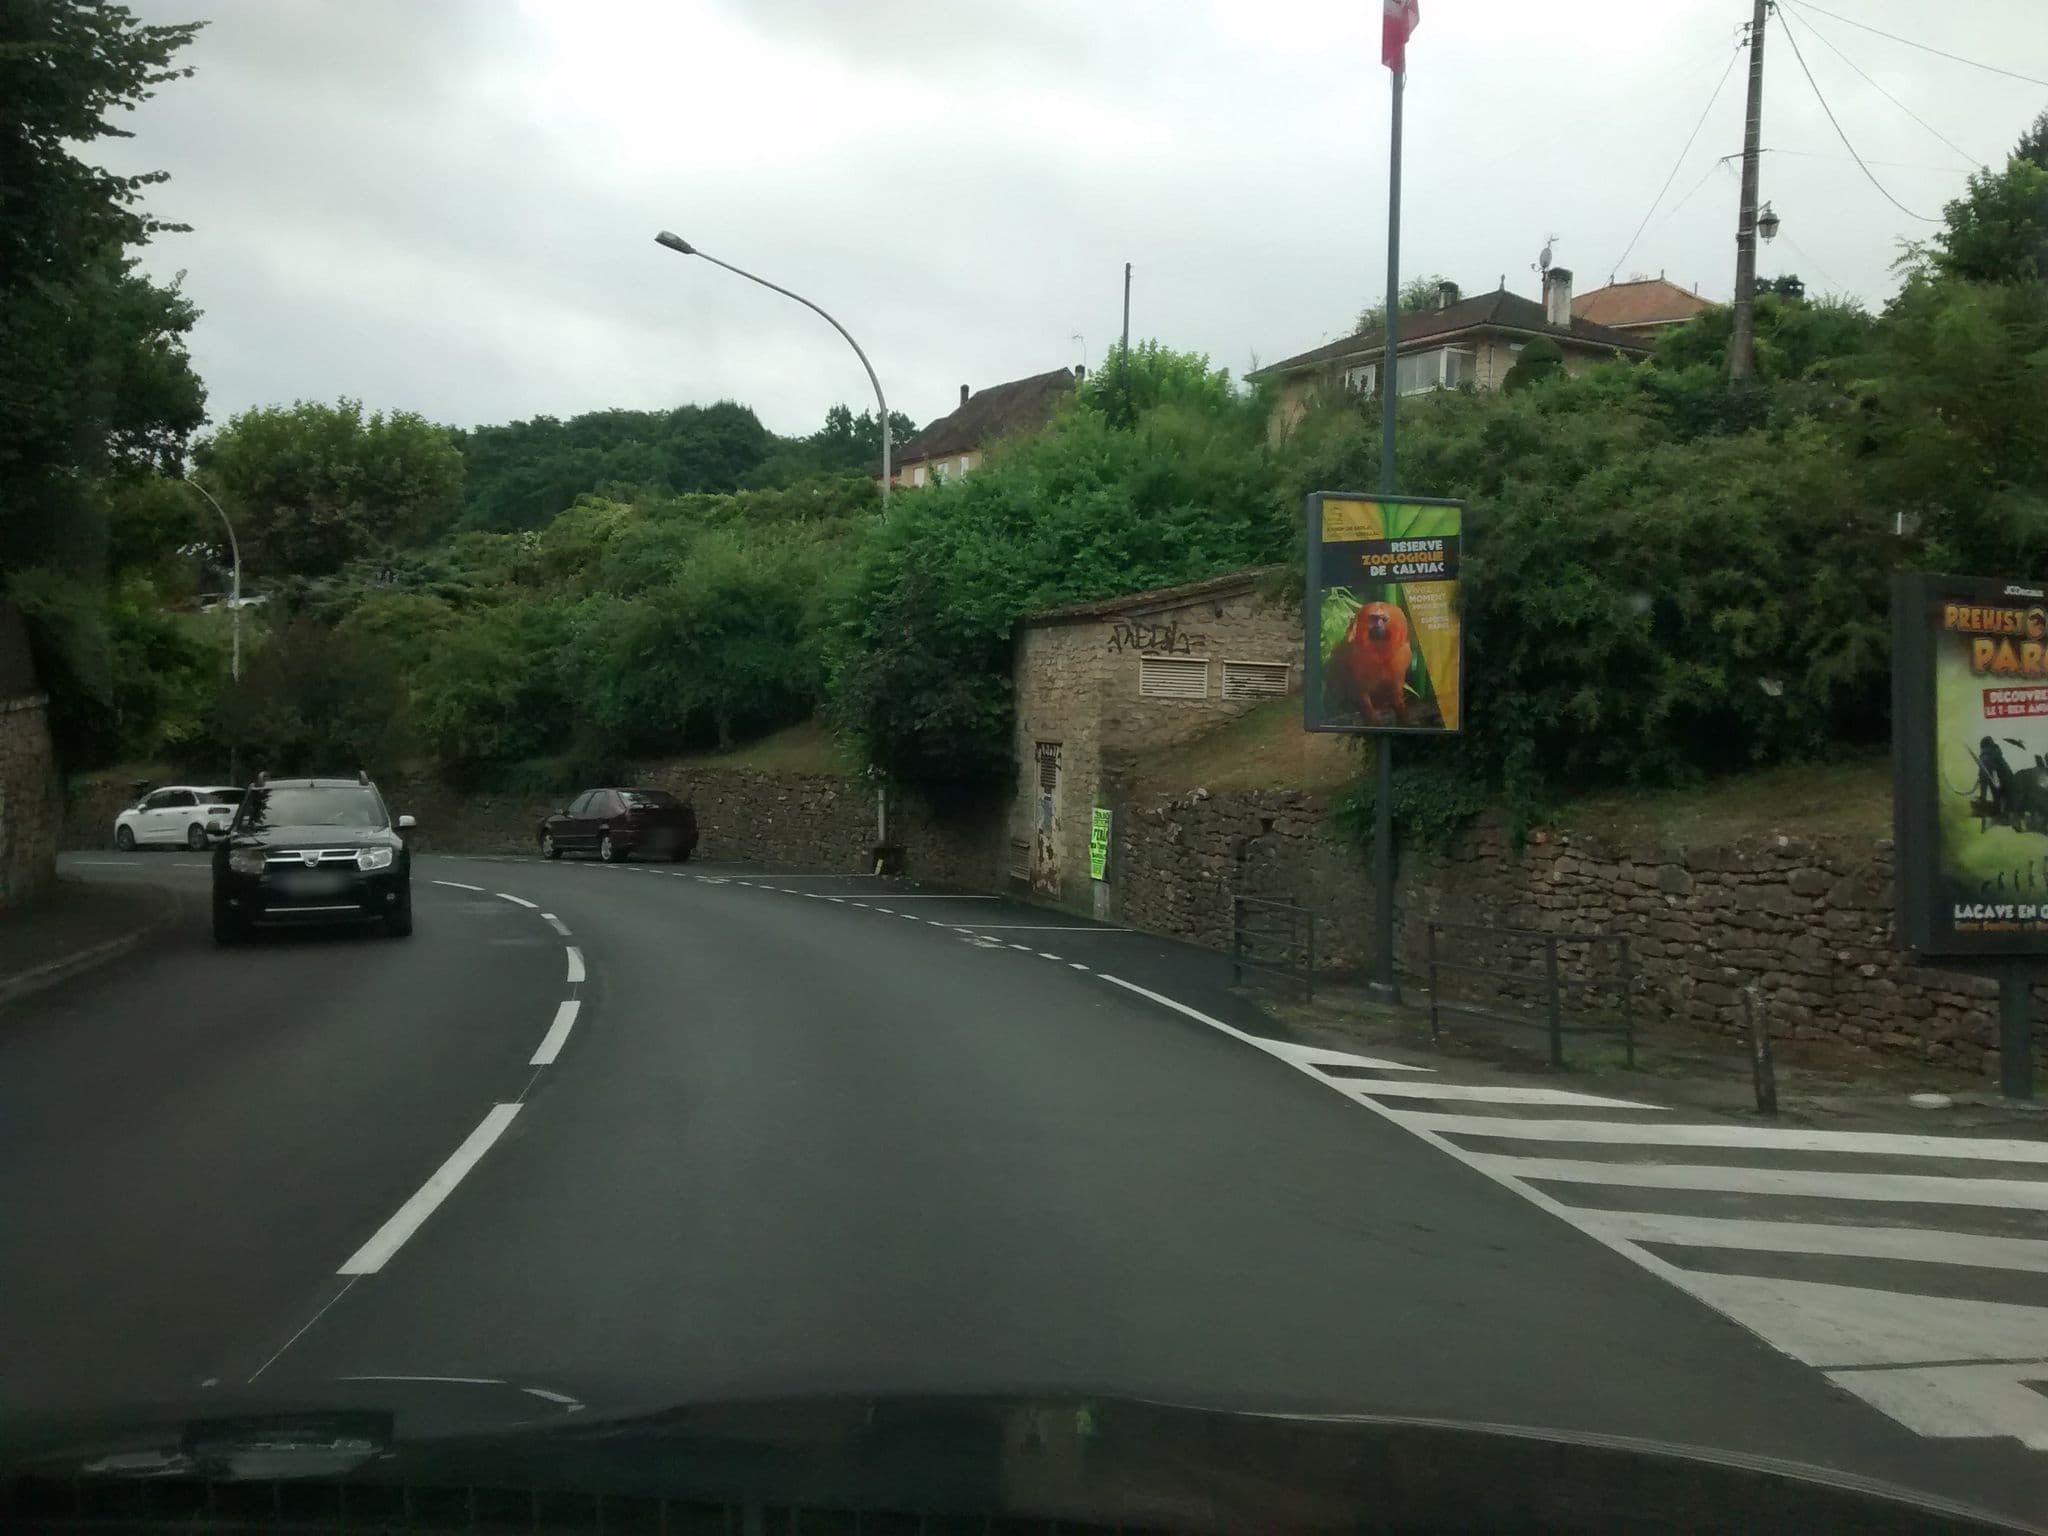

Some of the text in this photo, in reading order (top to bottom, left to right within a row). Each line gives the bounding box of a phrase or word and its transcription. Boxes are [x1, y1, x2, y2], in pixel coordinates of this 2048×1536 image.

[1362, 551, 1444, 565] ZOOLOGIQUE
[1370, 562, 1445, 576] DE CALVIAC
[1973, 638, 2048, 673] PAR
[1954, 904, 2014, 919] LACAVE
[2018, 904, 2036, 918] EN
